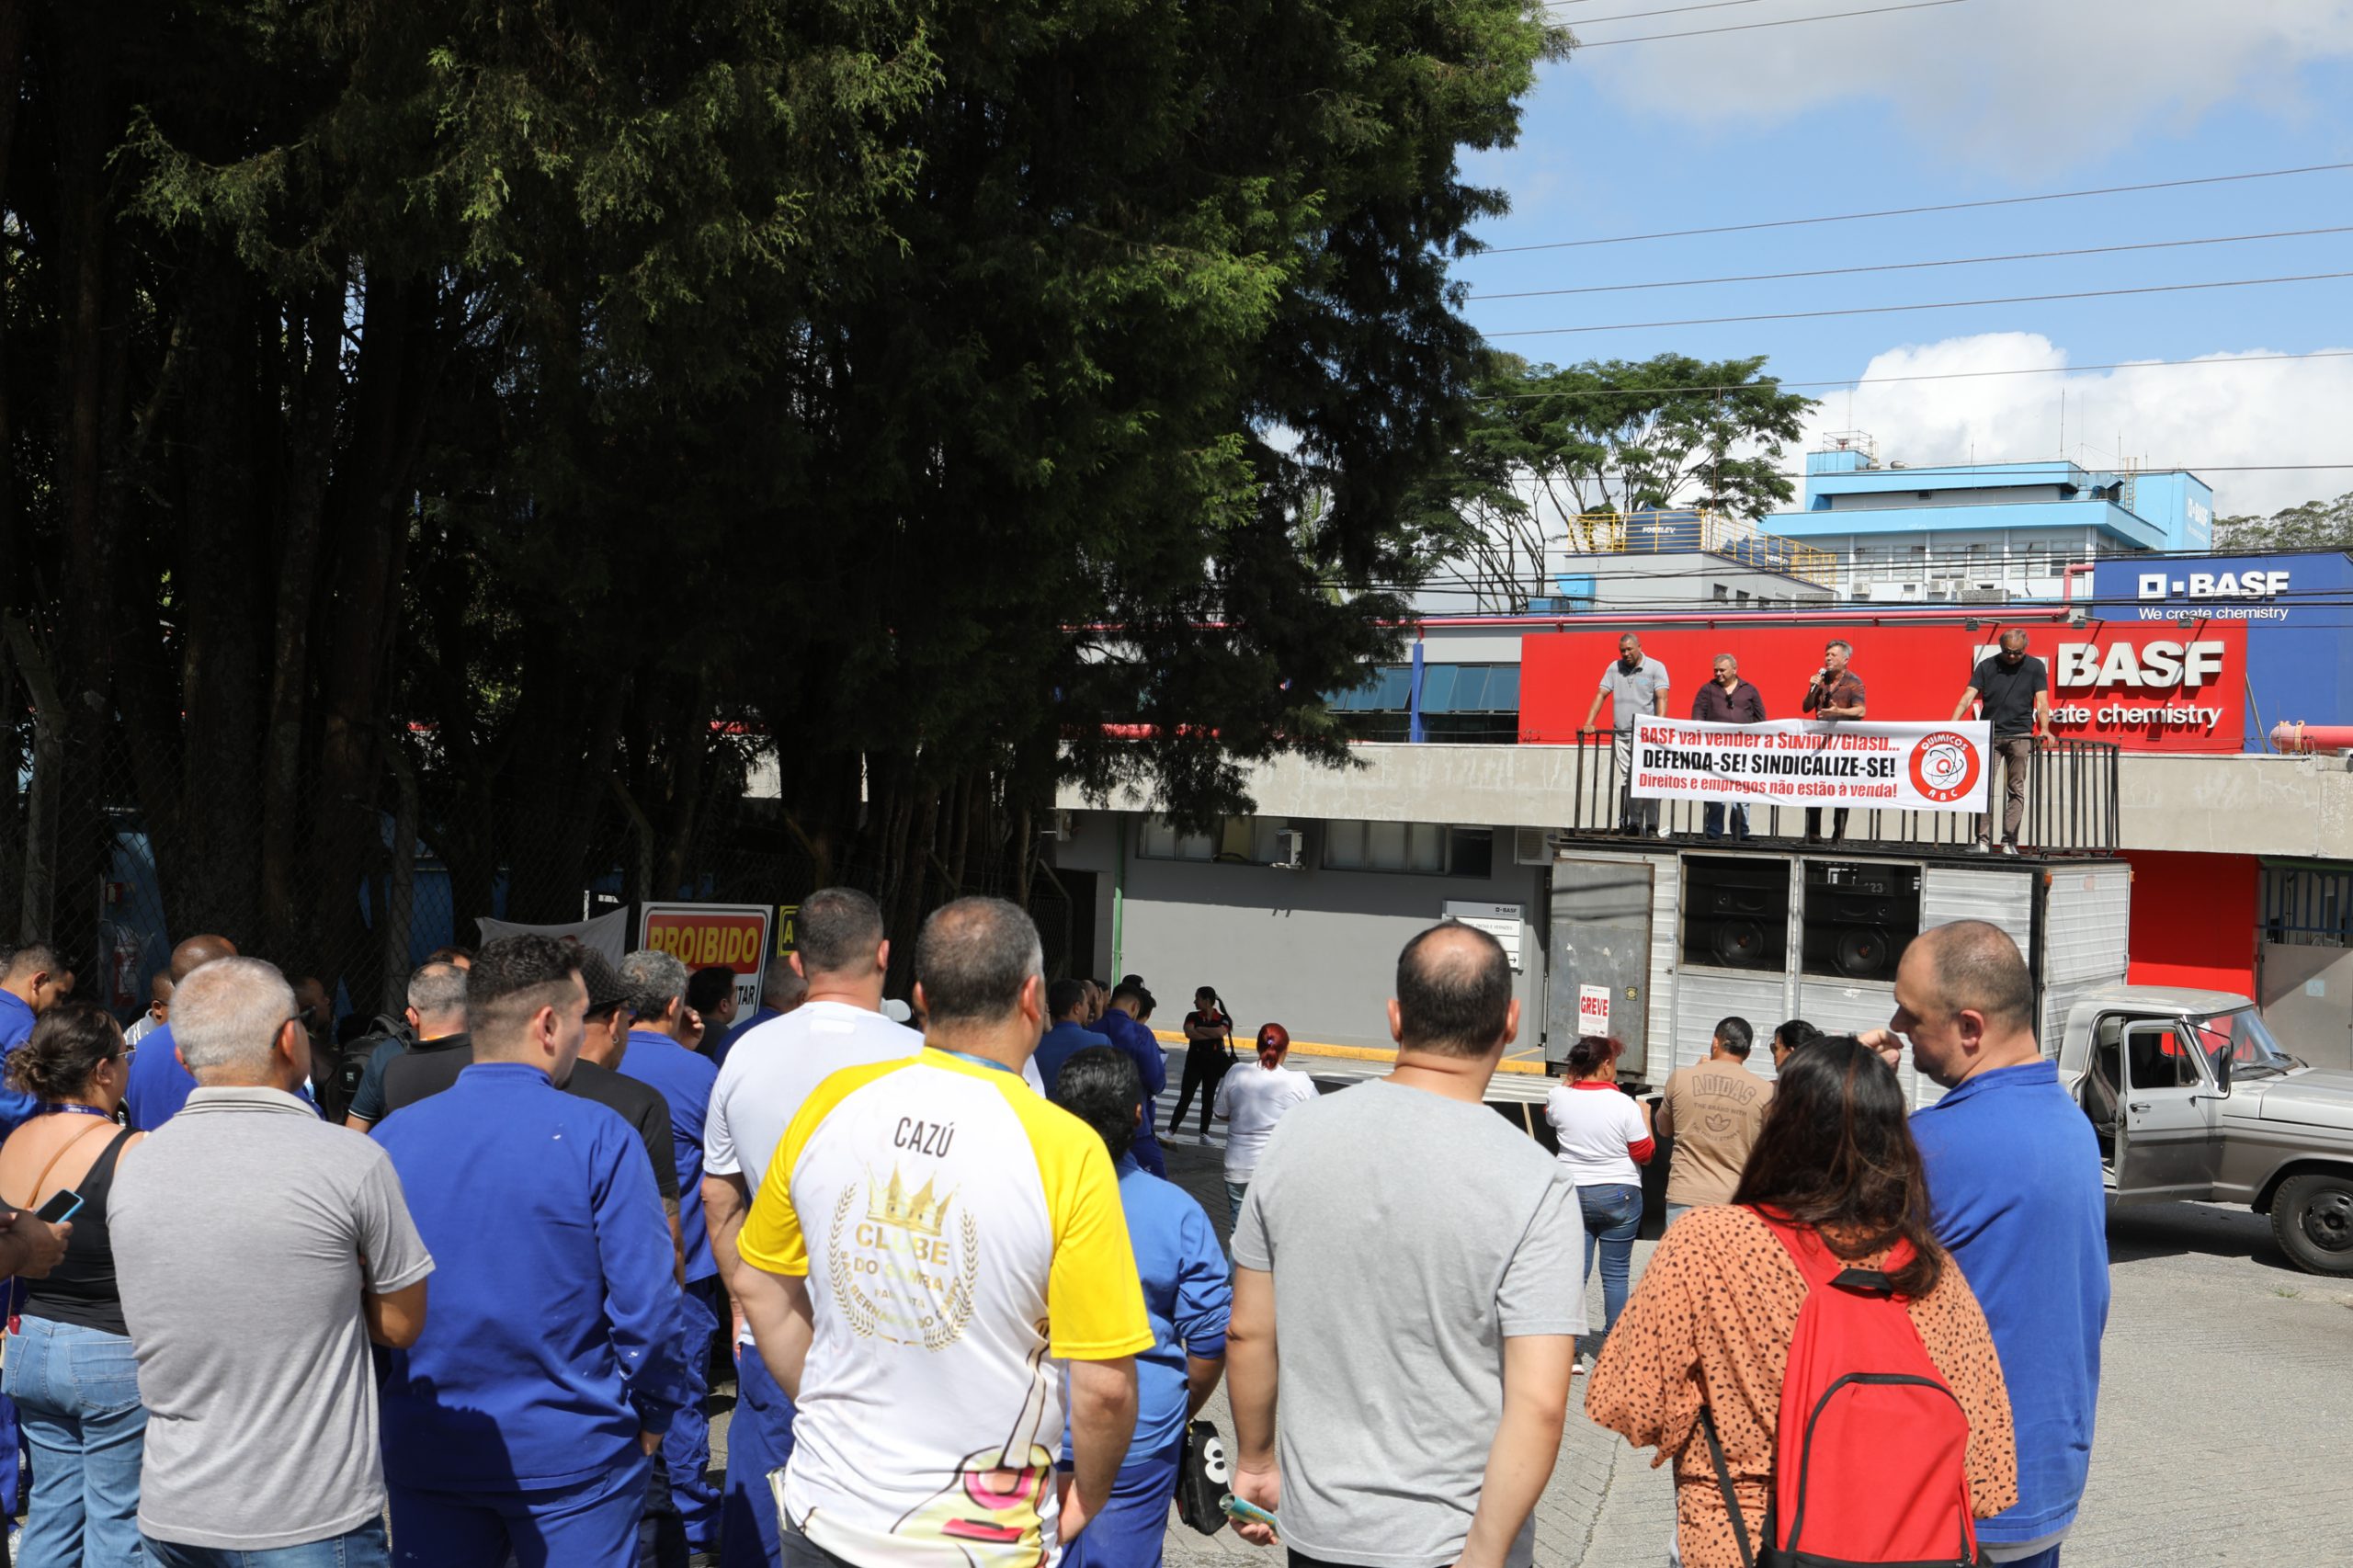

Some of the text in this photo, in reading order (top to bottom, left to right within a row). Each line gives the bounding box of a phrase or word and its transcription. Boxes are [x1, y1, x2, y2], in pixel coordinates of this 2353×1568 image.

[2189, 571, 2290, 600] BASF
[2139, 608, 2162, 620] We
[2216, 607, 2289, 621] chemistry
[2057, 641, 2224, 687] BASF
[2097, 703, 2223, 728] chemistry
[1641, 726, 1900, 751] BASF vai vender a Suvinil/Glasu...
[1921, 733, 1968, 751] QUÍMICOS
[1643, 749, 1895, 778] DEFENDA-SE! SINDICALIZE-SE!
[1639, 773, 1897, 798] Direitos e empregos não estão à venda!
[649, 926, 758, 964] PROIBIDO
[1581, 995, 1608, 1017] GREVE
[1692, 1074, 1756, 1106] ADIDAS
[1708, 1104, 1730, 1112] BRAND
[894, 1117, 954, 1158] CAZÚ
[856, 1222, 949, 1266] CLUBE
[854, 1256, 879, 1275] DO
